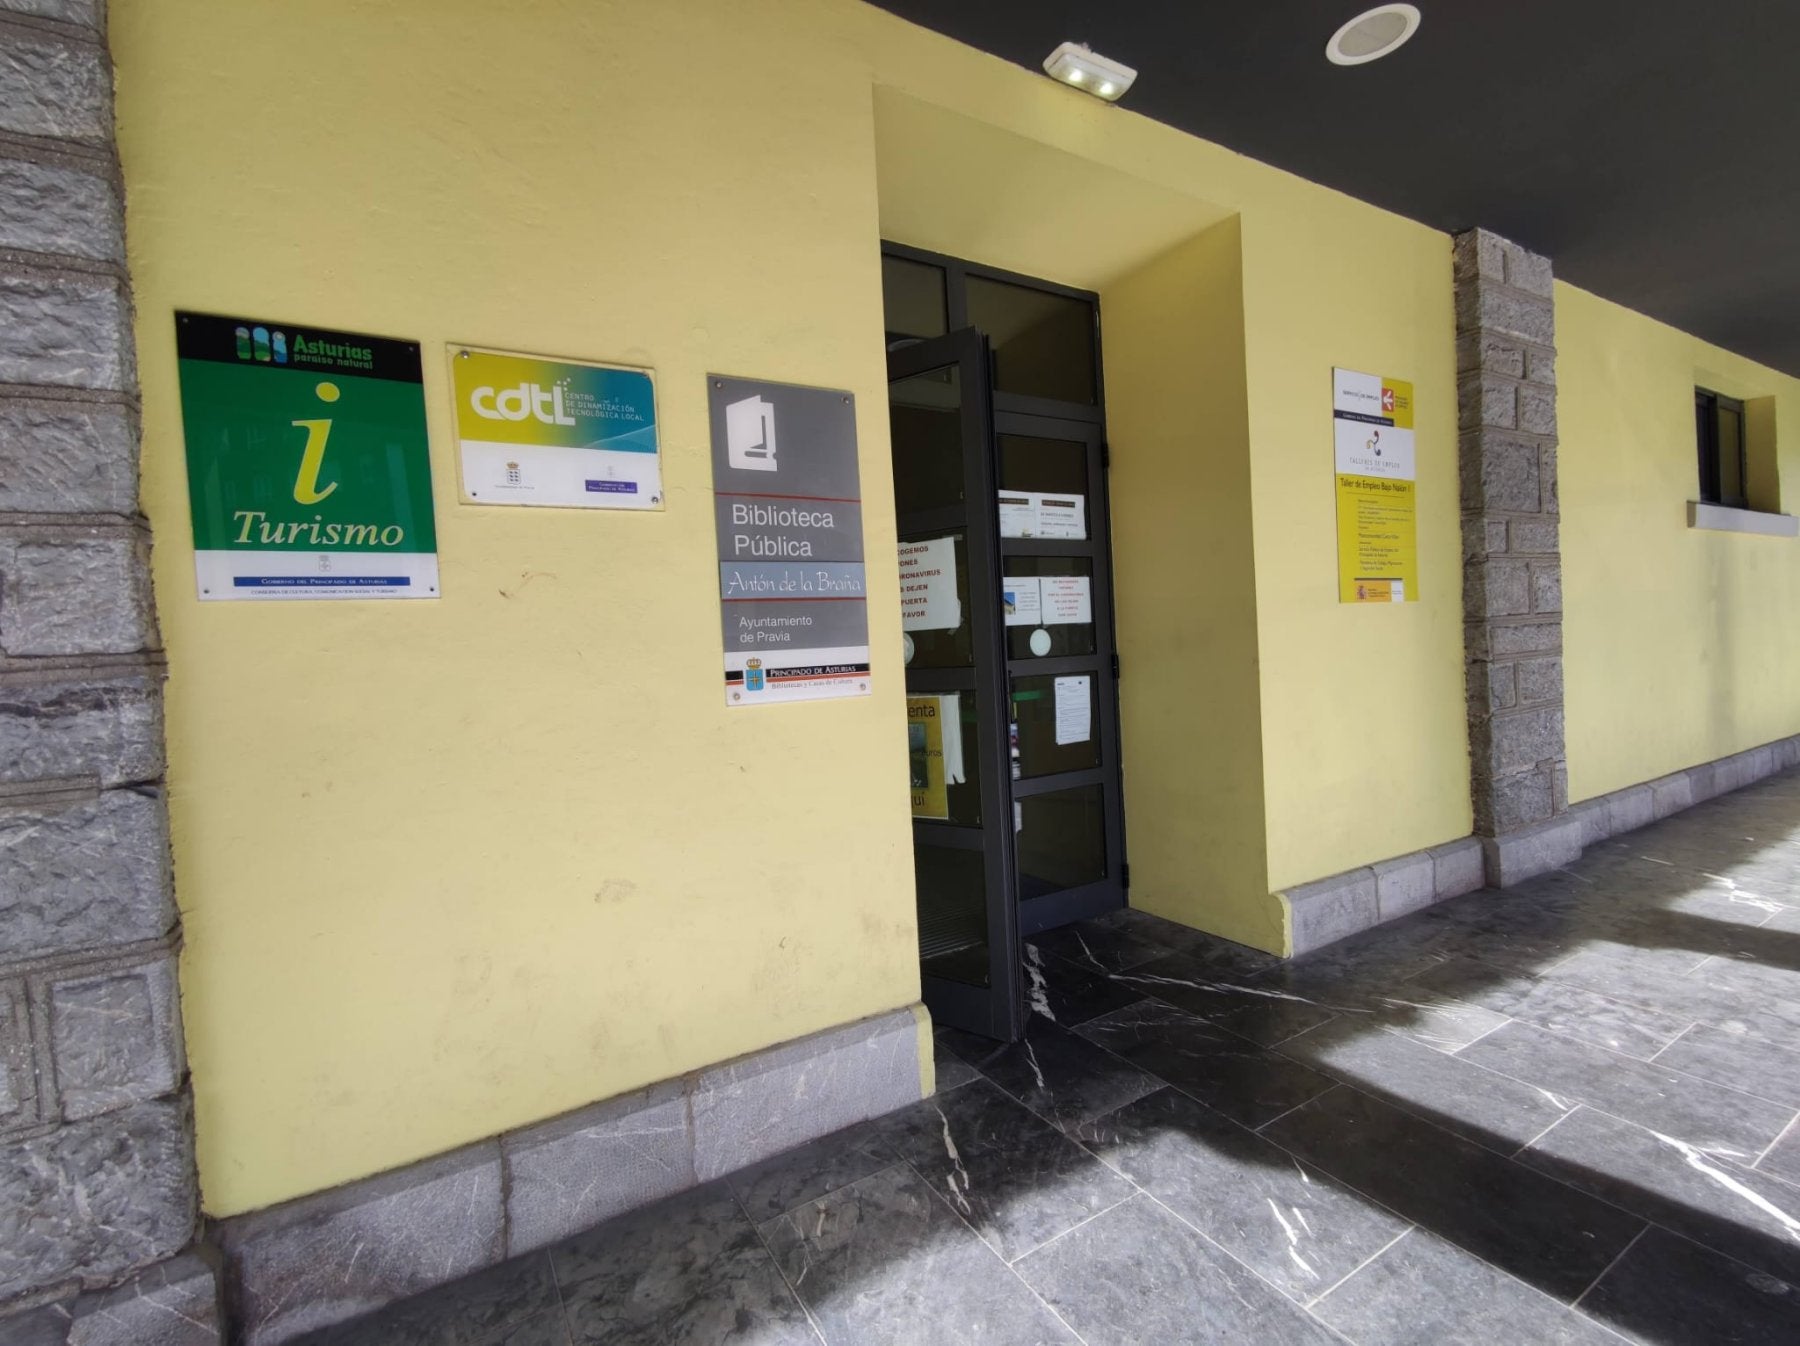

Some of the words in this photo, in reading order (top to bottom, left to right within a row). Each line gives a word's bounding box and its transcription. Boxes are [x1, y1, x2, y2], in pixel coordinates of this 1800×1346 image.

[293, 334, 373, 361] Asturias
[337, 358, 373, 370] natural
[565, 392, 595, 401] CENTRO
[565, 400, 576, 408] DE
[621, 412, 645, 422] LOCAL
[1340, 477, 1355, 488] Taller
[1355, 480, 1362, 489] de
[1362, 480, 1380, 492] Empleo
[732, 504, 835, 528] Biblioteca
[233, 511, 404, 546] Turismo
[734, 534, 813, 557] Pública
[728, 571, 776, 595] Antón
[779, 570, 797, 592] de
[800, 570, 814, 592] la
[816, 571, 862, 592] Braña
[906, 583, 928, 592] DEJEN
[739, 616, 813, 630] Ayuntamiento
[740, 633, 754, 643] de
[757, 631, 791, 642] Pravia
[770, 667, 812, 677] PRINCIPADO
[814, 666, 823, 674] DE
[825, 665, 857, 674] ASTURIAS
[908, 703, 936, 718] enta
